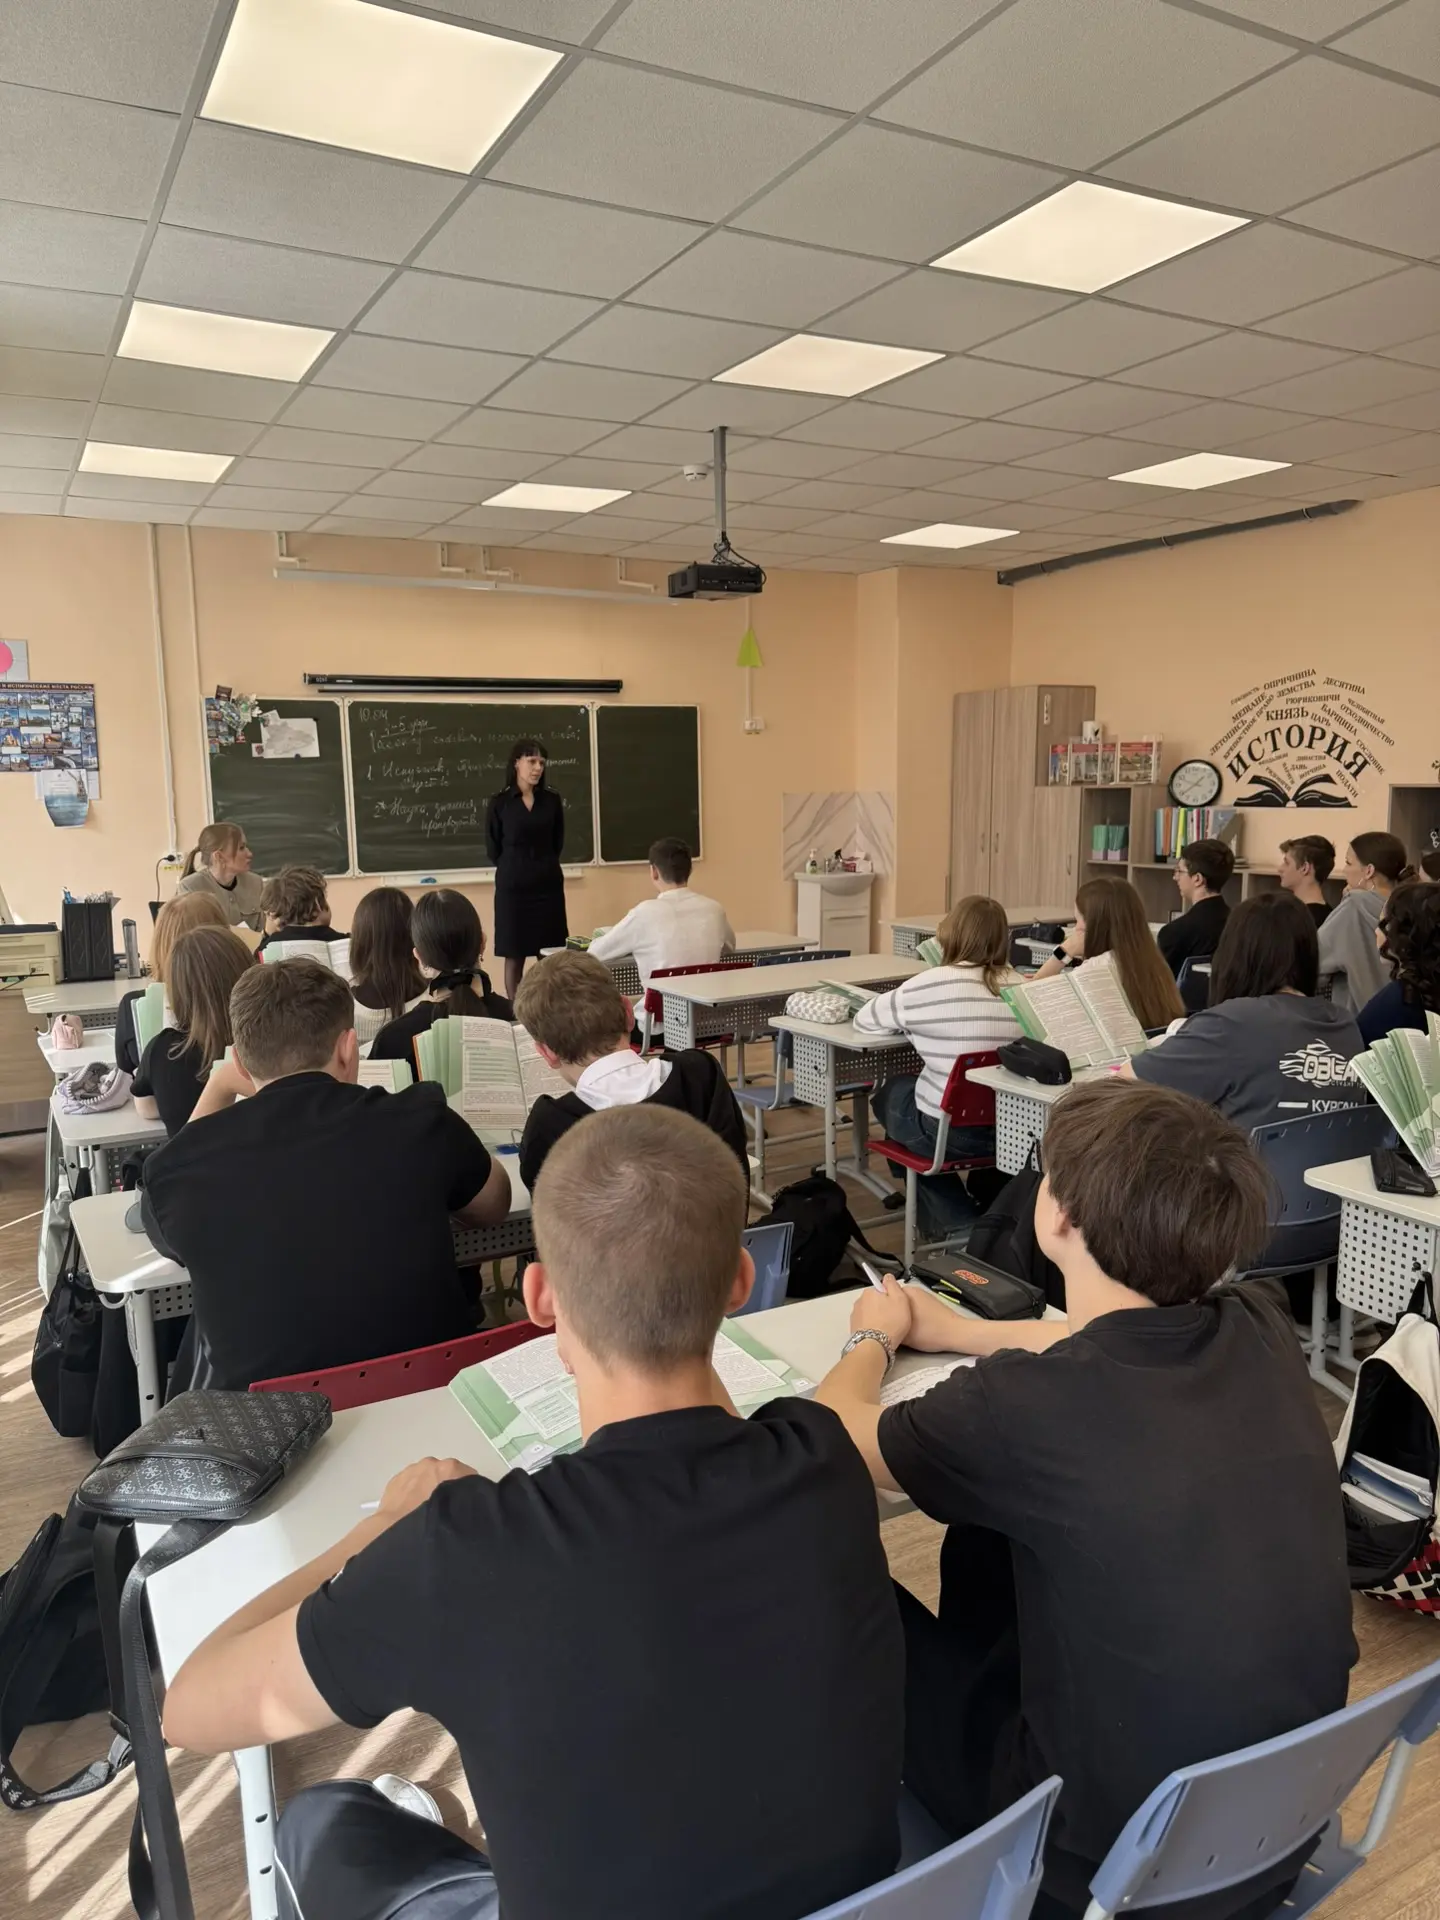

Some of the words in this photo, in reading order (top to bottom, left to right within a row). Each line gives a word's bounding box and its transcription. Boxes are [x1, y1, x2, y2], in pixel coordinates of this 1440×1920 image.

[1263, 668, 1317, 691] ОПРИЧНИНА
[1276, 679, 1316, 698] ЗЕМСТВА
[1322, 676, 1366, 695] ДЕСЯТИНА
[1231, 692, 1268, 724] МЕЩАНЕ
[1255, 693, 1275, 718] ПРАВО
[1285, 693, 1341, 705] РЮРИКОВИЧИ
[1347, 697, 1386, 725] ЧЕЛОБИТНАЯ
[1266, 706, 1309, 721] КНЯЗЬ
[1310, 712, 1332, 728] ЦАРЬ
[1320, 703, 1358, 737] БАРЩИНА
[1340, 703, 1395, 747] ОТХОДНИЧЕСТВО
[1209, 719, 1248, 756] ЛЕТОПИСЬ
[1226, 724, 1372, 782] ИСТОРИЯ
[1356, 739, 1386, 776] СОСЛОВИЕ
[1335, 769, 1359, 799] ПОДАТИ
